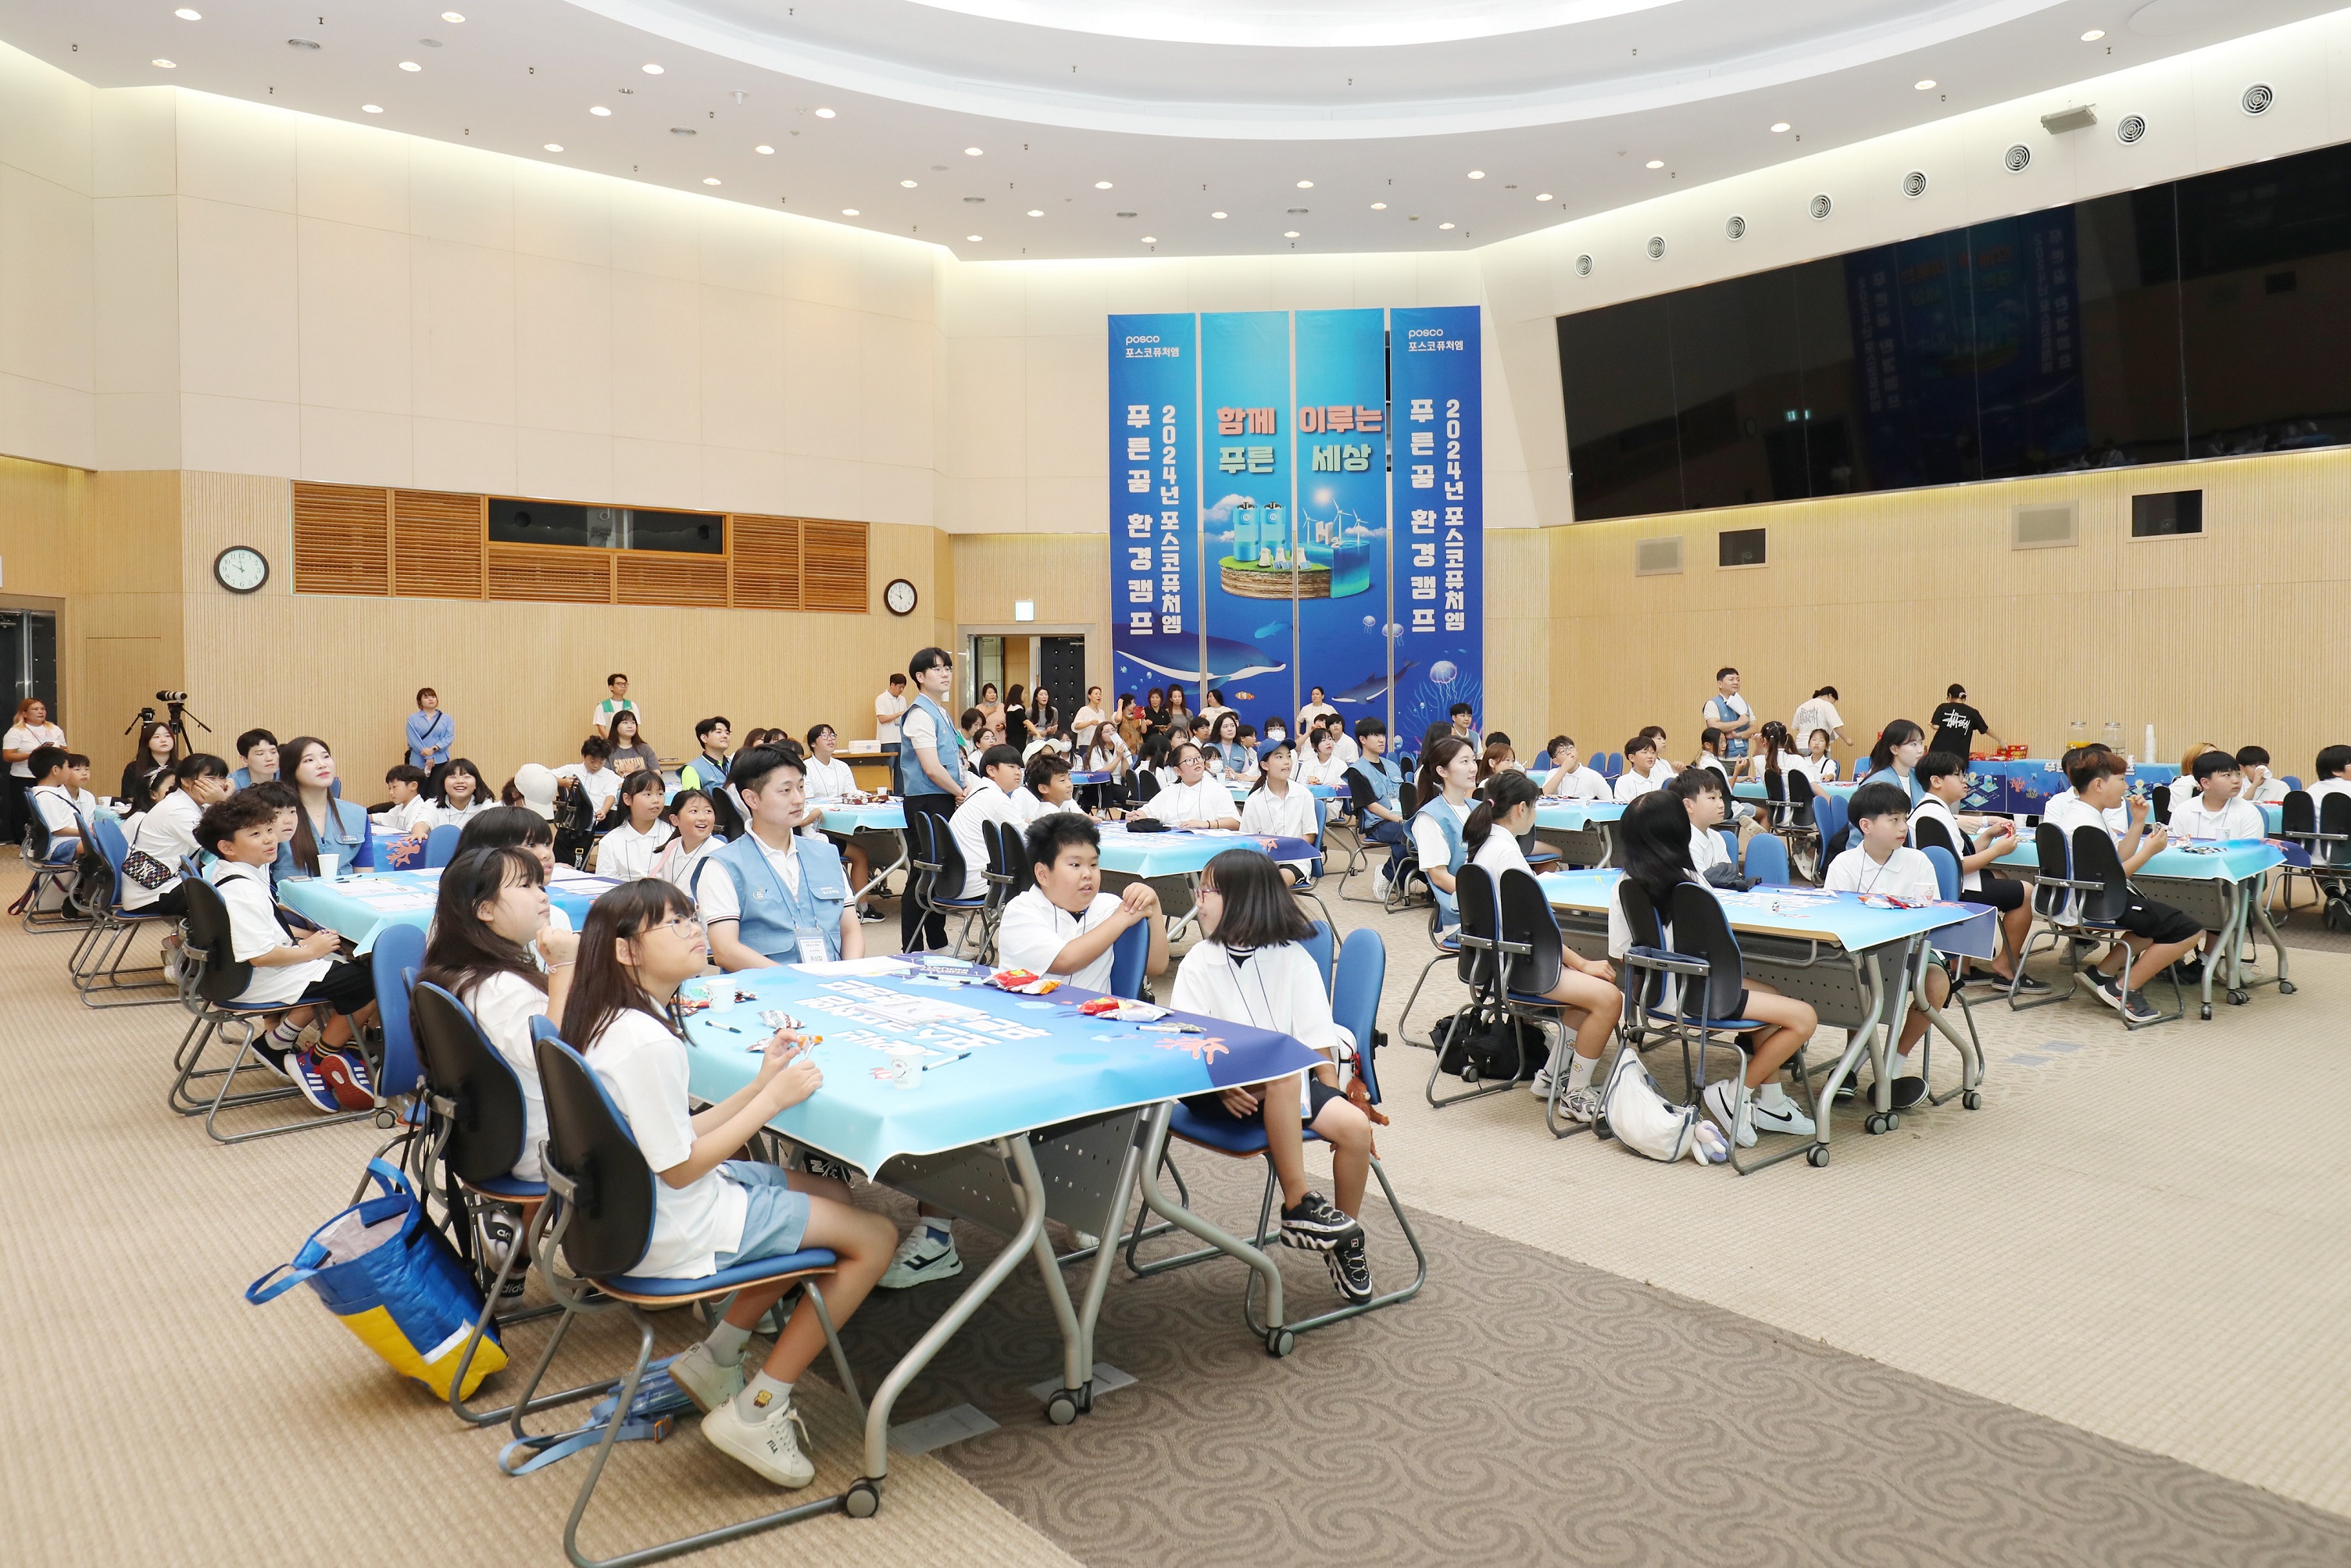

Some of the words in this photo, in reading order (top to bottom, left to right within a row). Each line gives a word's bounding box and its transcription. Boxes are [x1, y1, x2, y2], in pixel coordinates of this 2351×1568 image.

[1125, 347, 1179, 358] 포스코퓨처엠
[1126, 335, 1160, 346] posco
[1408, 340, 1463, 352] 포스코퓨처엠
[1409, 328, 1444, 340] posco
[1127, 405, 1151, 493] 푸른꿈
[1217, 405, 1277, 435] 함께
[1298, 405, 1383, 434] 이루는
[1410, 399, 1435, 489] 푸른꿈
[1160, 405, 1180, 505] 2024년
[1219, 445, 1275, 473] 푸른
[1312, 443, 1371, 472] 세상
[1444, 399, 1463, 501] 2024년
[1127, 513, 1153, 635] 환경캠프
[1160, 511, 1181, 634] 포스코퓨처엠
[1410, 509, 1437, 632] 환경캠프
[1444, 507, 1465, 631] 포스코퓨처엠
[280, 1027, 296, 1038] WANT
[766, 1440, 778, 1454] FILA
